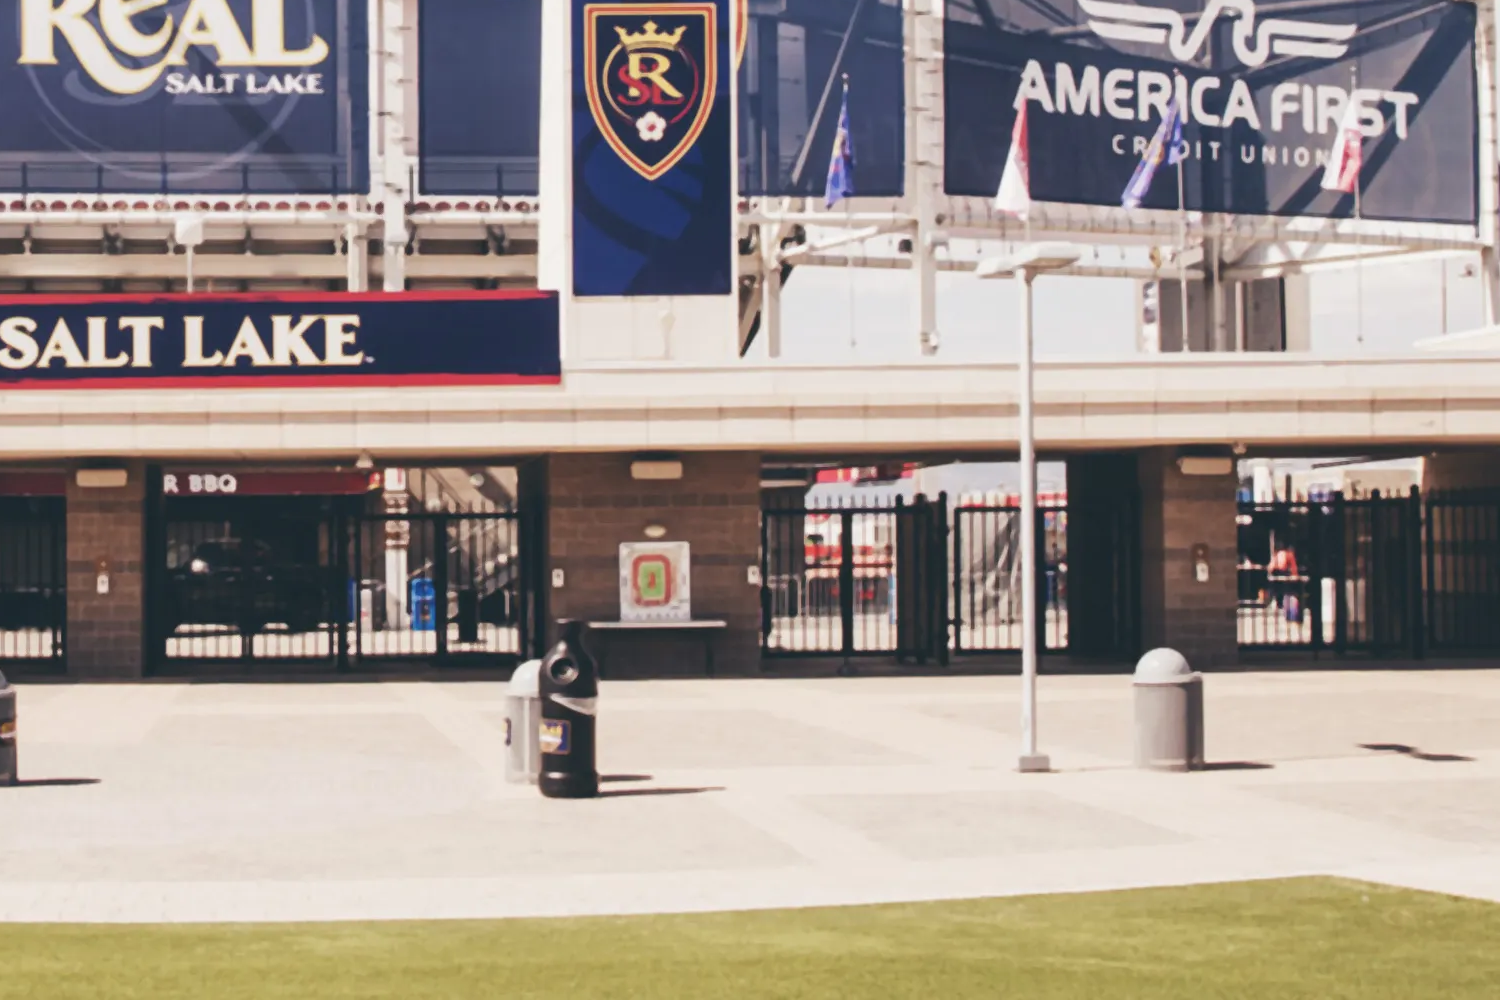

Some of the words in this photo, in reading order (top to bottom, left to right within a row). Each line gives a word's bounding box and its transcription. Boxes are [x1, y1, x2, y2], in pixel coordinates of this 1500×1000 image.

[164, 73, 240, 95] SALT
[246, 73, 325, 95] LAKE
[1012, 58, 1262, 131] AMERICA
[1271, 81, 1420, 141] FIRST
[1111, 133, 1220, 162] CRDIT
[1240, 145, 1332, 169] UNION
[181, 313, 365, 369] LAKE
[188, 474, 238, 494] BBQ
